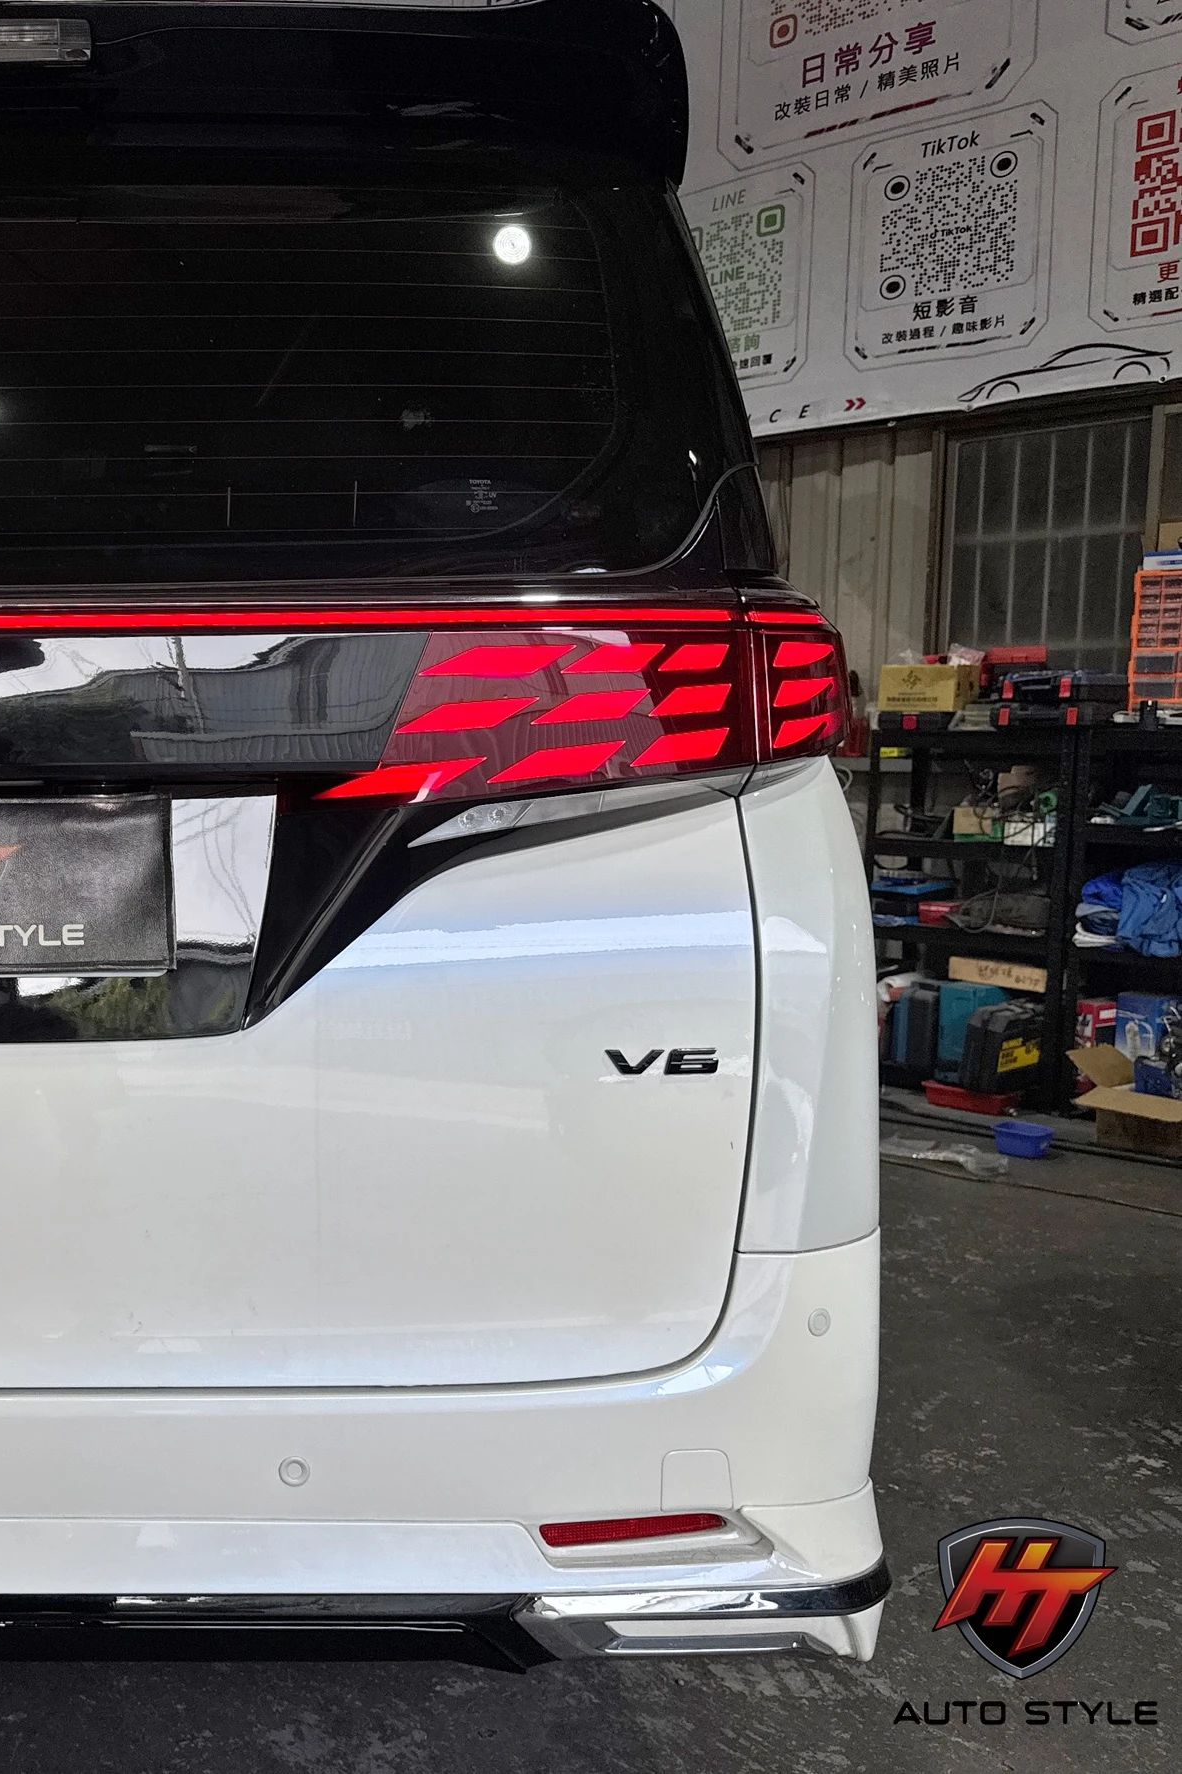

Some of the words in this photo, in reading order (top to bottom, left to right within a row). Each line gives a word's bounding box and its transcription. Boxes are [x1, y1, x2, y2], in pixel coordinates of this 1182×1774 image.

[801, 20, 937, 89] 日常分享
[774, 83, 852, 121] 改裝日常
[877, 51, 960, 92] 精美照片
[921, 130, 980, 158] TikTok
[711, 188, 747, 212] LINE
[941, 224, 972, 237] TikTok
[710, 265, 745, 286] LINE
[1156, 260, 1180, 283] 更
[912, 295, 978, 321] 短影音
[1132, 285, 1182, 306] 精選配
[881, 326, 935, 344] 改裝過程
[951, 314, 1005, 335] 趣味影片
[604, 1047, 719, 1076] V6
